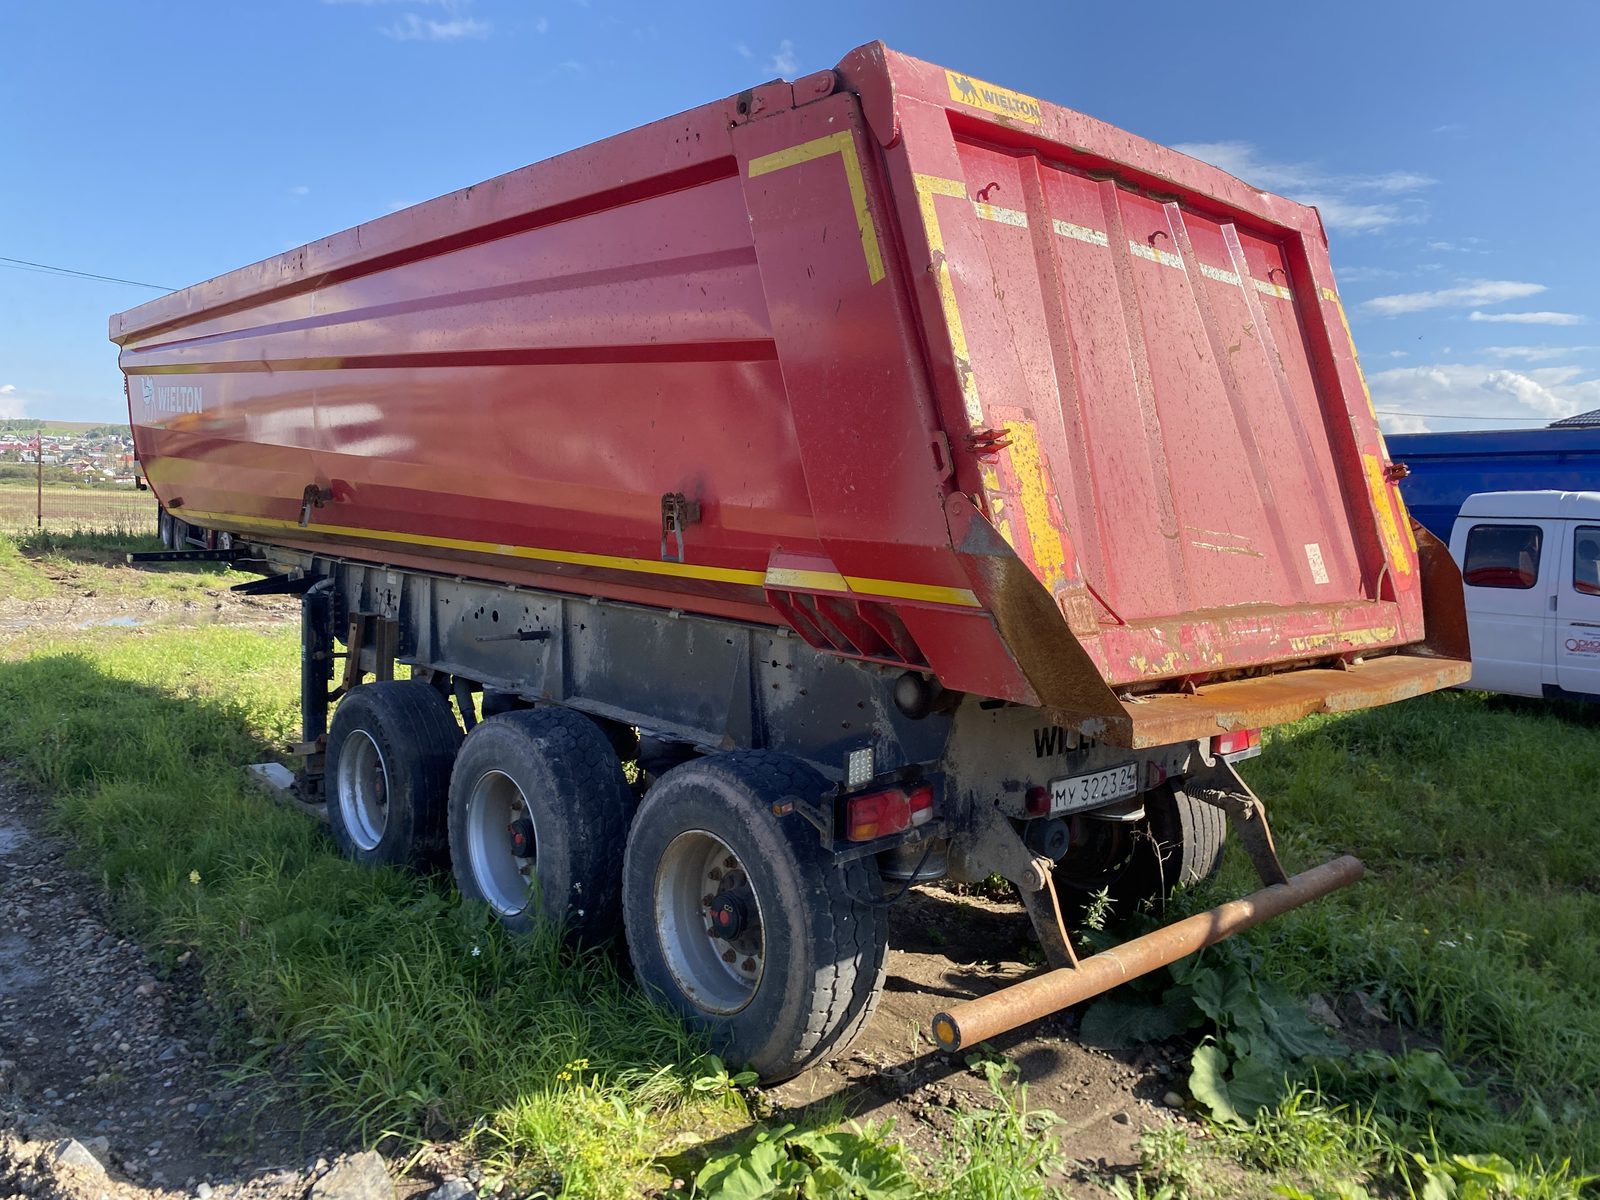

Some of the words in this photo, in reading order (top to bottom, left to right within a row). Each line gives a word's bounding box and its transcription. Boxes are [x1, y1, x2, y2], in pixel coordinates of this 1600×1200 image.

[981, 88, 1041, 118] WIELTON
[158, 386, 203, 414] WIELTON
[1081, 772, 1117, 801] 3223
